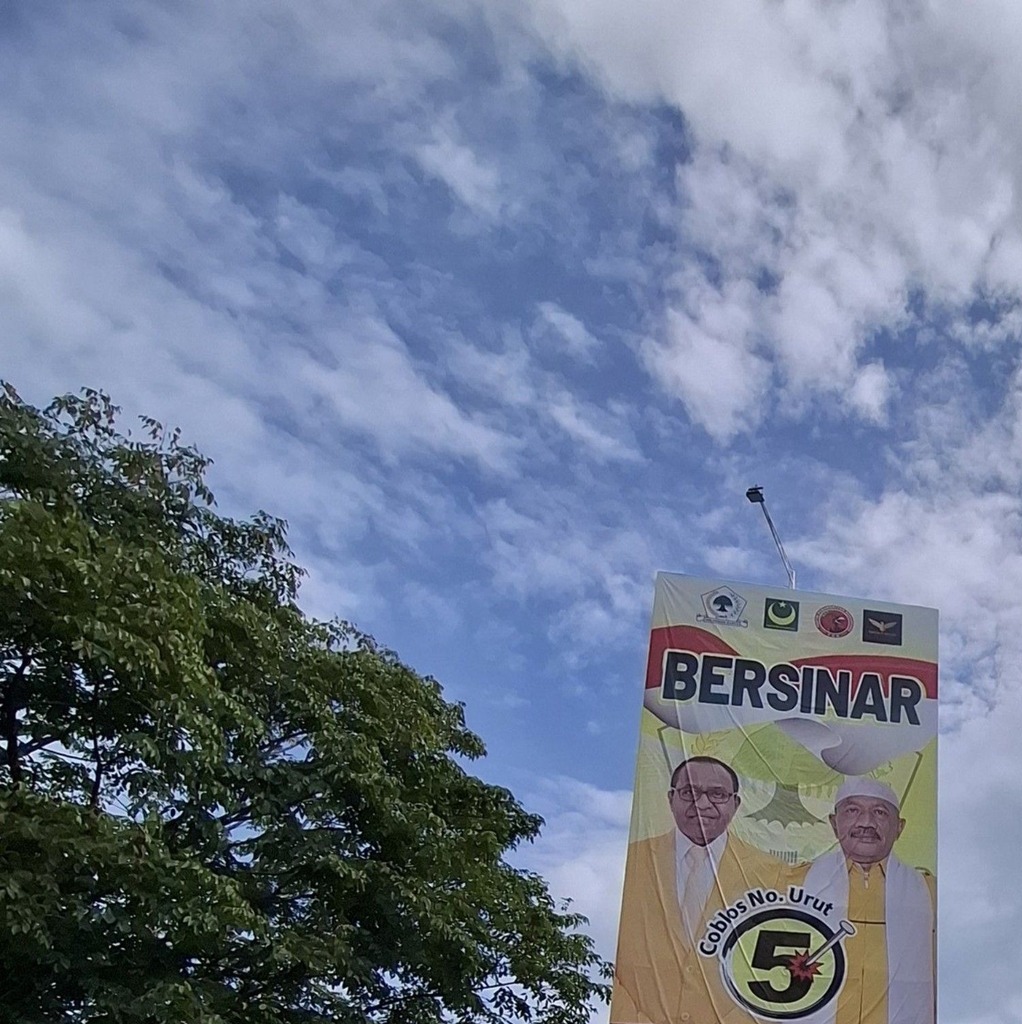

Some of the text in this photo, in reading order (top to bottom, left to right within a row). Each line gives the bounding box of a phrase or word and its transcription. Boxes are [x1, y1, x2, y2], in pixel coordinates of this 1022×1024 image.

[661, 650, 922, 726] BERSINAR
[699, 886, 834, 956] Coblos No. Urut
[747, 930, 814, 1004] 5
